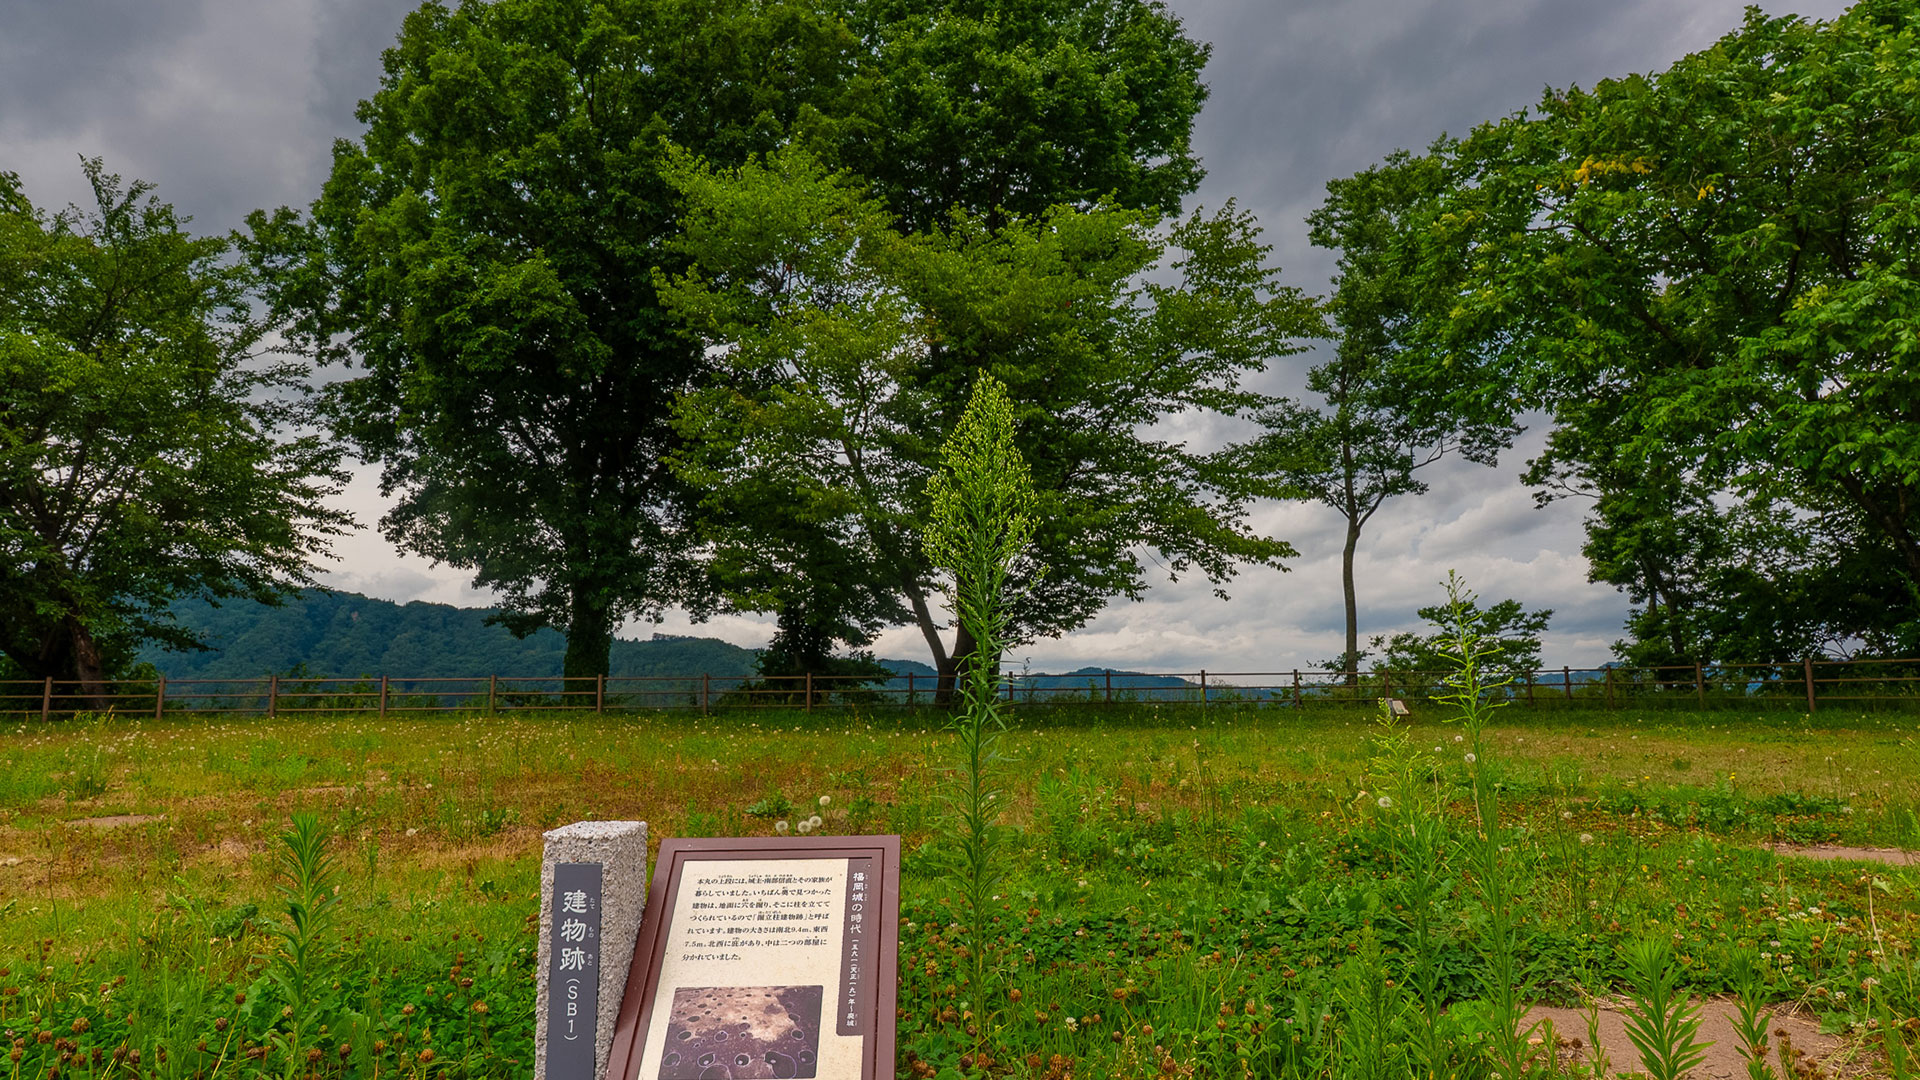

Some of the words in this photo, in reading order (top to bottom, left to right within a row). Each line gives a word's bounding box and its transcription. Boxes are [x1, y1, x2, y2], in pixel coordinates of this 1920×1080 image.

[589, 897, 595, 910] たて
[588, 926, 595, 938] もの
[587, 953, 593, 966] あと
[682, 953, 741, 961] 分かれていました。
